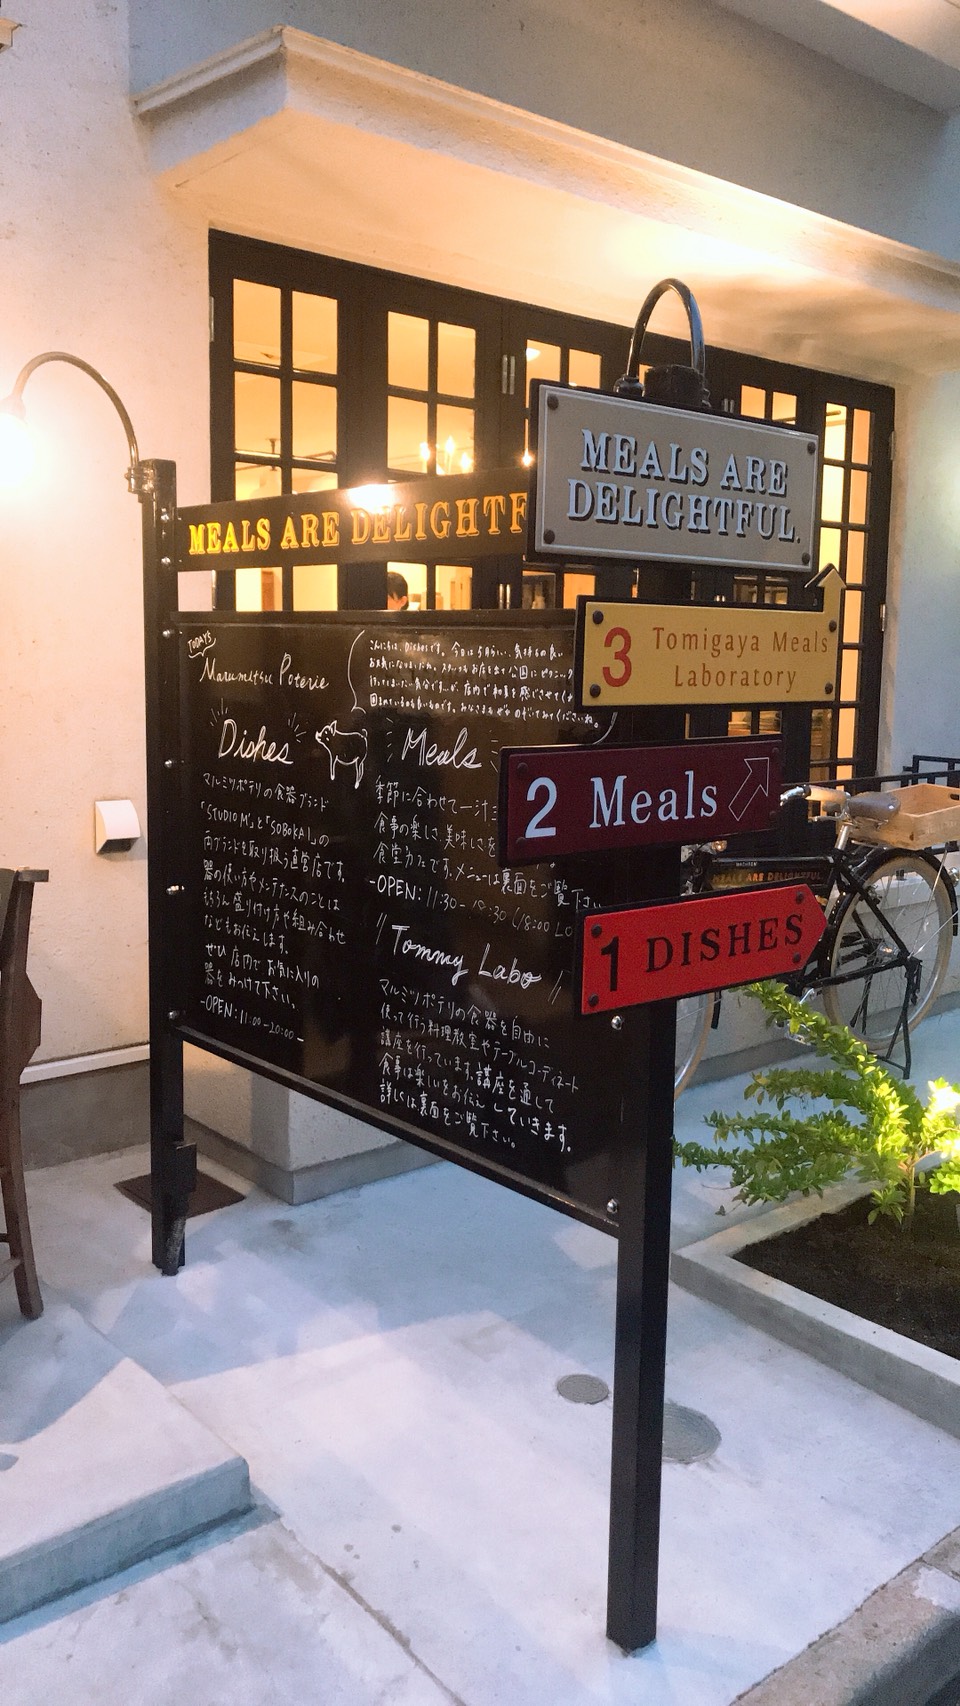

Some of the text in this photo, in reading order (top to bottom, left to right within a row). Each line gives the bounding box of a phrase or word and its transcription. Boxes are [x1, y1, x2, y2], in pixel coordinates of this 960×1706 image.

[581, 428, 788, 497] MEALS ARE
[189, 516, 270, 555] MEALS
[280, 511, 340, 549] ARE
[567, 479, 800, 543] DELIGHTFUL.
[200, 652, 330, 690] Marumitsu Poterie
[602, 626, 828, 688] 3 Tomigaya Meals
[675, 663, 796, 692] Laboratory
[218, 718, 293, 764] Dishes
[401, 727, 482, 769] Meals
[525, 770, 718, 839] 2 Meals
[746, 872, 764, 882] ARE
[391, 924, 542, 989] Tommy Labo
[601, 914, 804, 992] 1 DISHES
